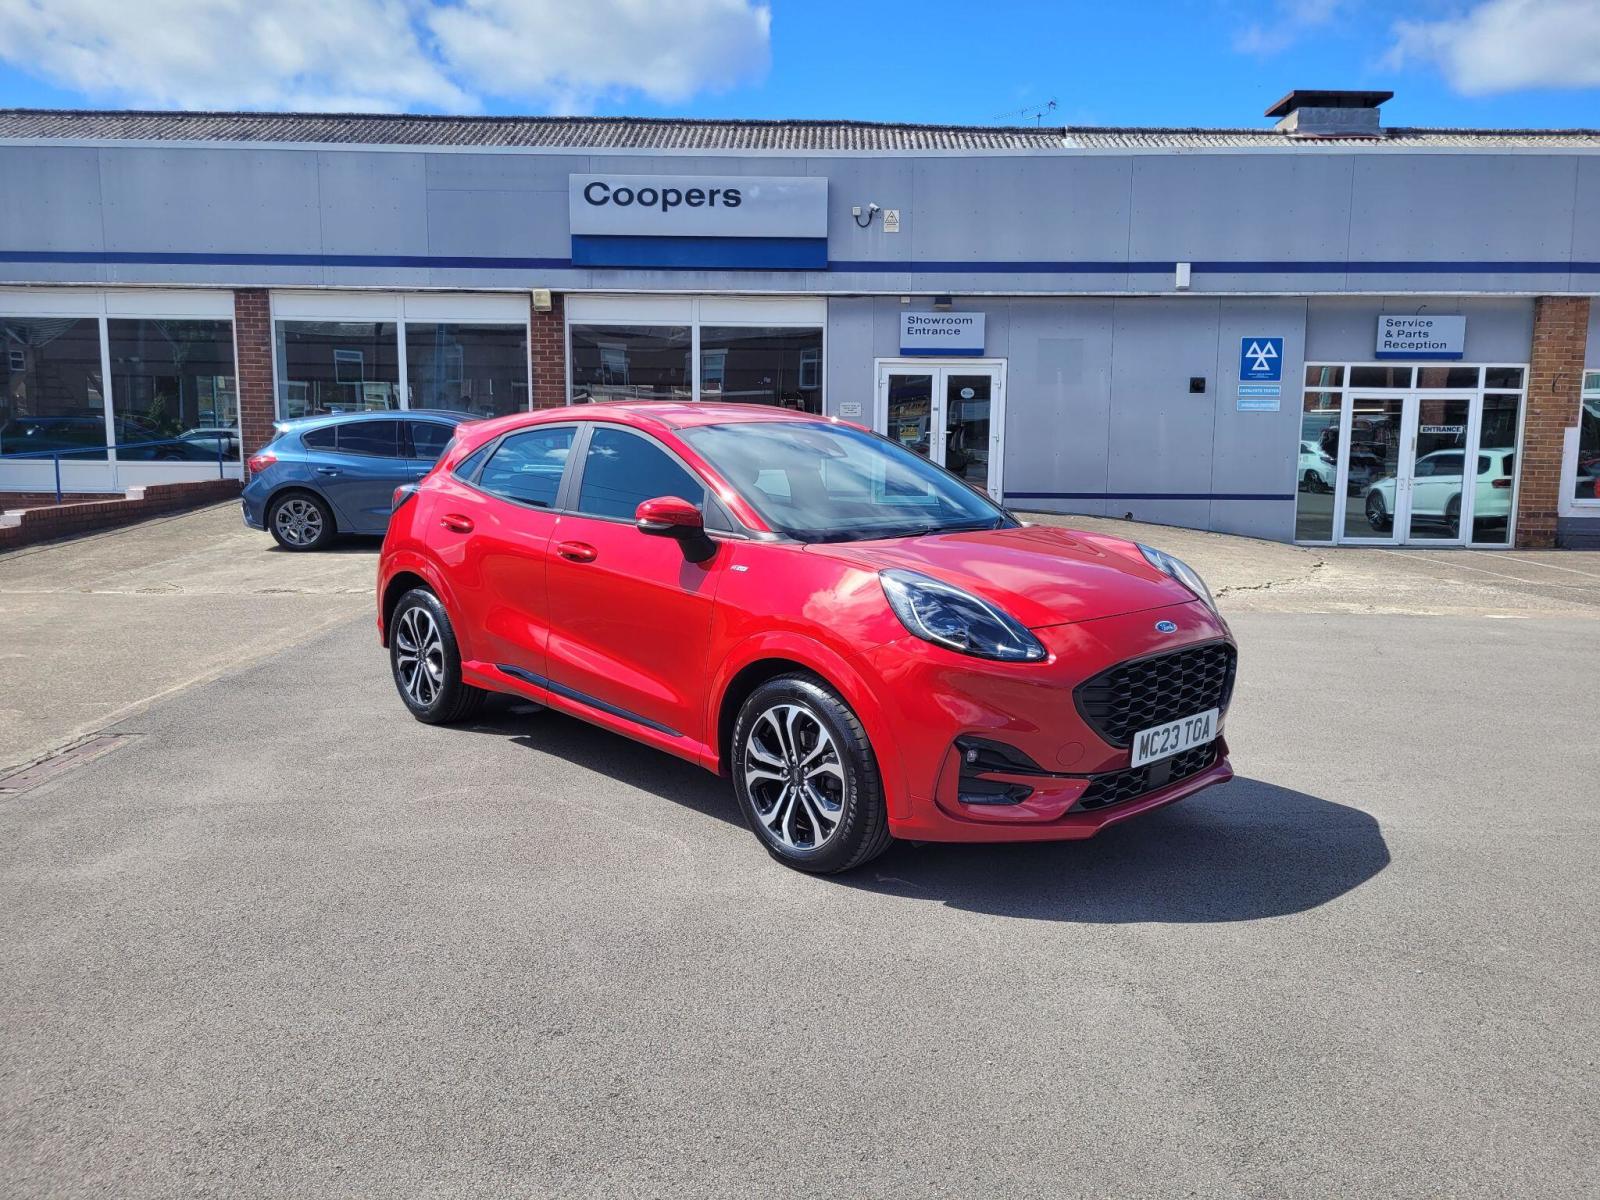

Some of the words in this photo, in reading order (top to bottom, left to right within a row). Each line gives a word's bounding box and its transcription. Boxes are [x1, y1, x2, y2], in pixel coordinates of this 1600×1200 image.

[583, 181, 742, 212] Coopers
[907, 316, 973, 325] Showroom
[1386, 318, 1433, 328] Service
[907, 326, 961, 335] Entrance
[1385, 329, 1393, 338] &
[1397, 329, 1430, 338] Parts
[1384, 340, 1447, 350] Reception
[1138, 724, 1181, 760] MC23
[1184, 715, 1210, 745] TOA
